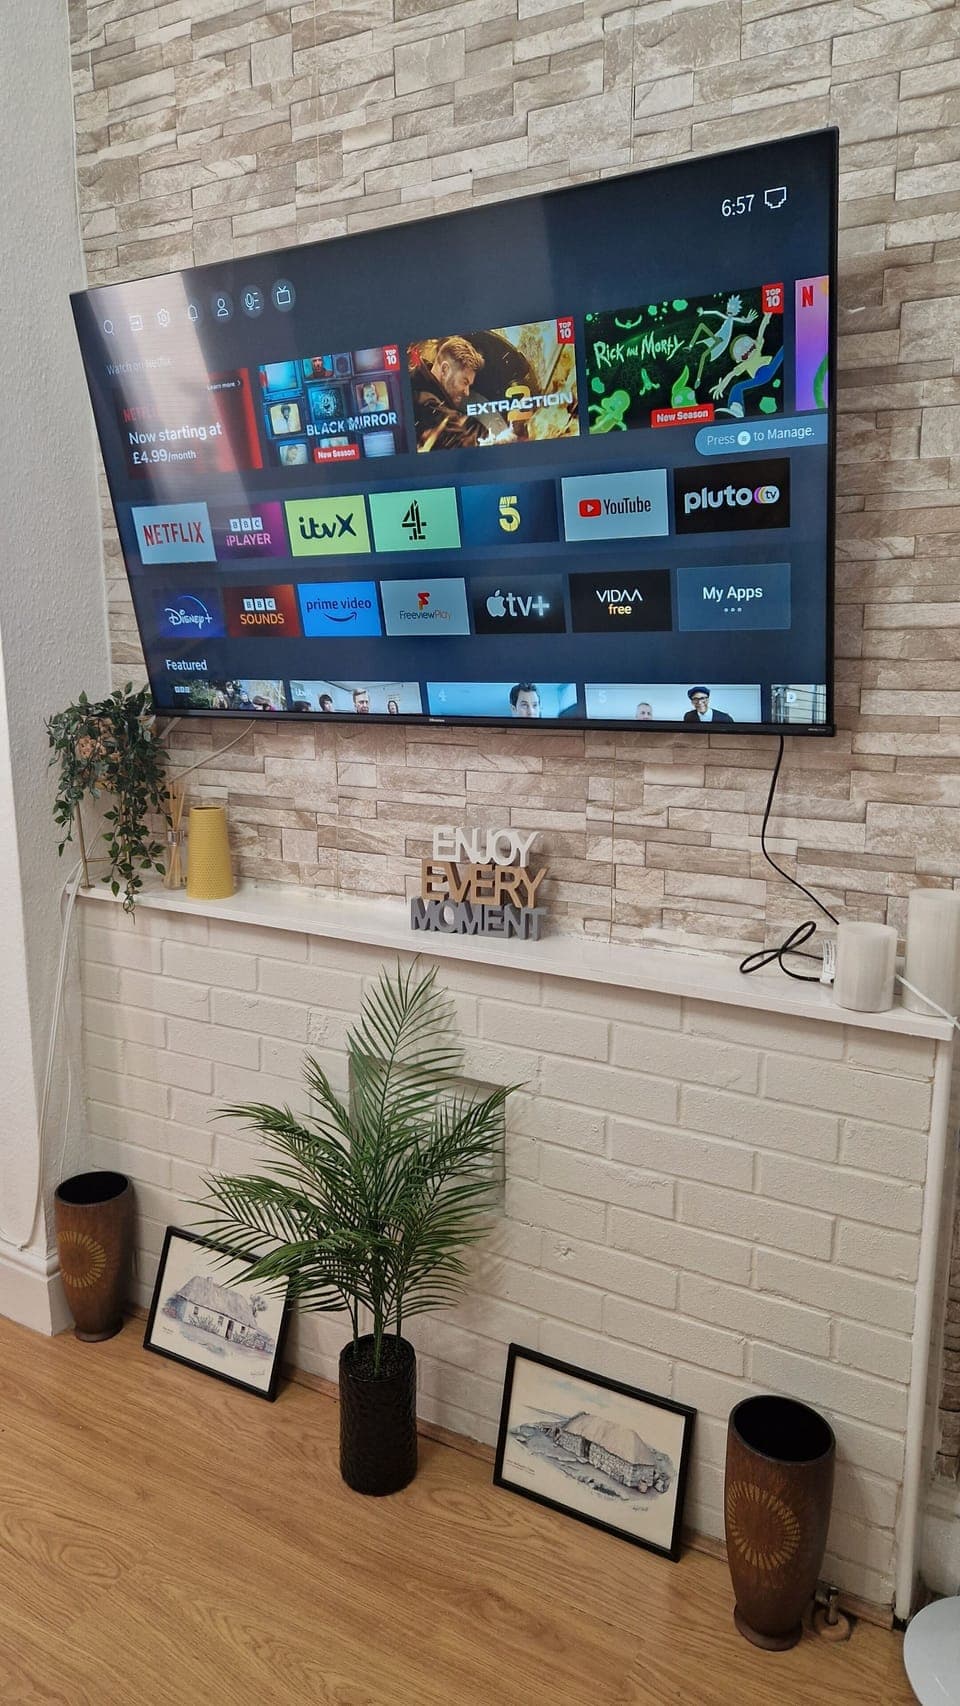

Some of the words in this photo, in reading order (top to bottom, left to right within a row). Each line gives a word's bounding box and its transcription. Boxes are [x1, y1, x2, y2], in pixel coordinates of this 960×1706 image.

[722, 194, 755, 217] 6:57
[765, 288, 781, 298] TOP
[766, 296, 780, 308] 10
[559, 321, 572, 329] TOP
[559, 328, 571, 340] 10
[386, 355, 397, 365] 10
[466, 391, 573, 416] EXTRACTION
[306, 420, 345, 436] BLACK
[349, 412, 398, 431] MIRROR
[656, 412, 675, 423] New
[676, 409, 709, 421] Season
[128, 431, 156, 445] Now
[159, 424, 207, 441] starting
[209, 421, 223, 437] at
[707, 433, 735, 446] Press
[753, 430, 765, 442] to
[767, 425, 815, 443] Manage.
[133, 448, 197, 465] £4.99/month
[603, 496, 652, 515] YouTube
[684, 485, 752, 514] pluto
[229, 517, 263, 532] BBC
[401, 500, 427, 540] 4
[143, 521, 205, 547] NETFLIX
[226, 533, 272, 547] iPLAYER
[703, 586, 723, 601] My
[727, 585, 763, 601] Apps
[243, 598, 277, 611] BBC
[306, 599, 338, 612] prime
[339, 597, 372, 610] video
[608, 604, 632, 615] free
[239, 614, 285, 625] SOUNDS
[165, 659, 208, 671] Featured
[432, 826, 542, 868] ENJOY
[421, 857, 551, 909] EVERY
[410, 896, 548, 941] MOMENT
